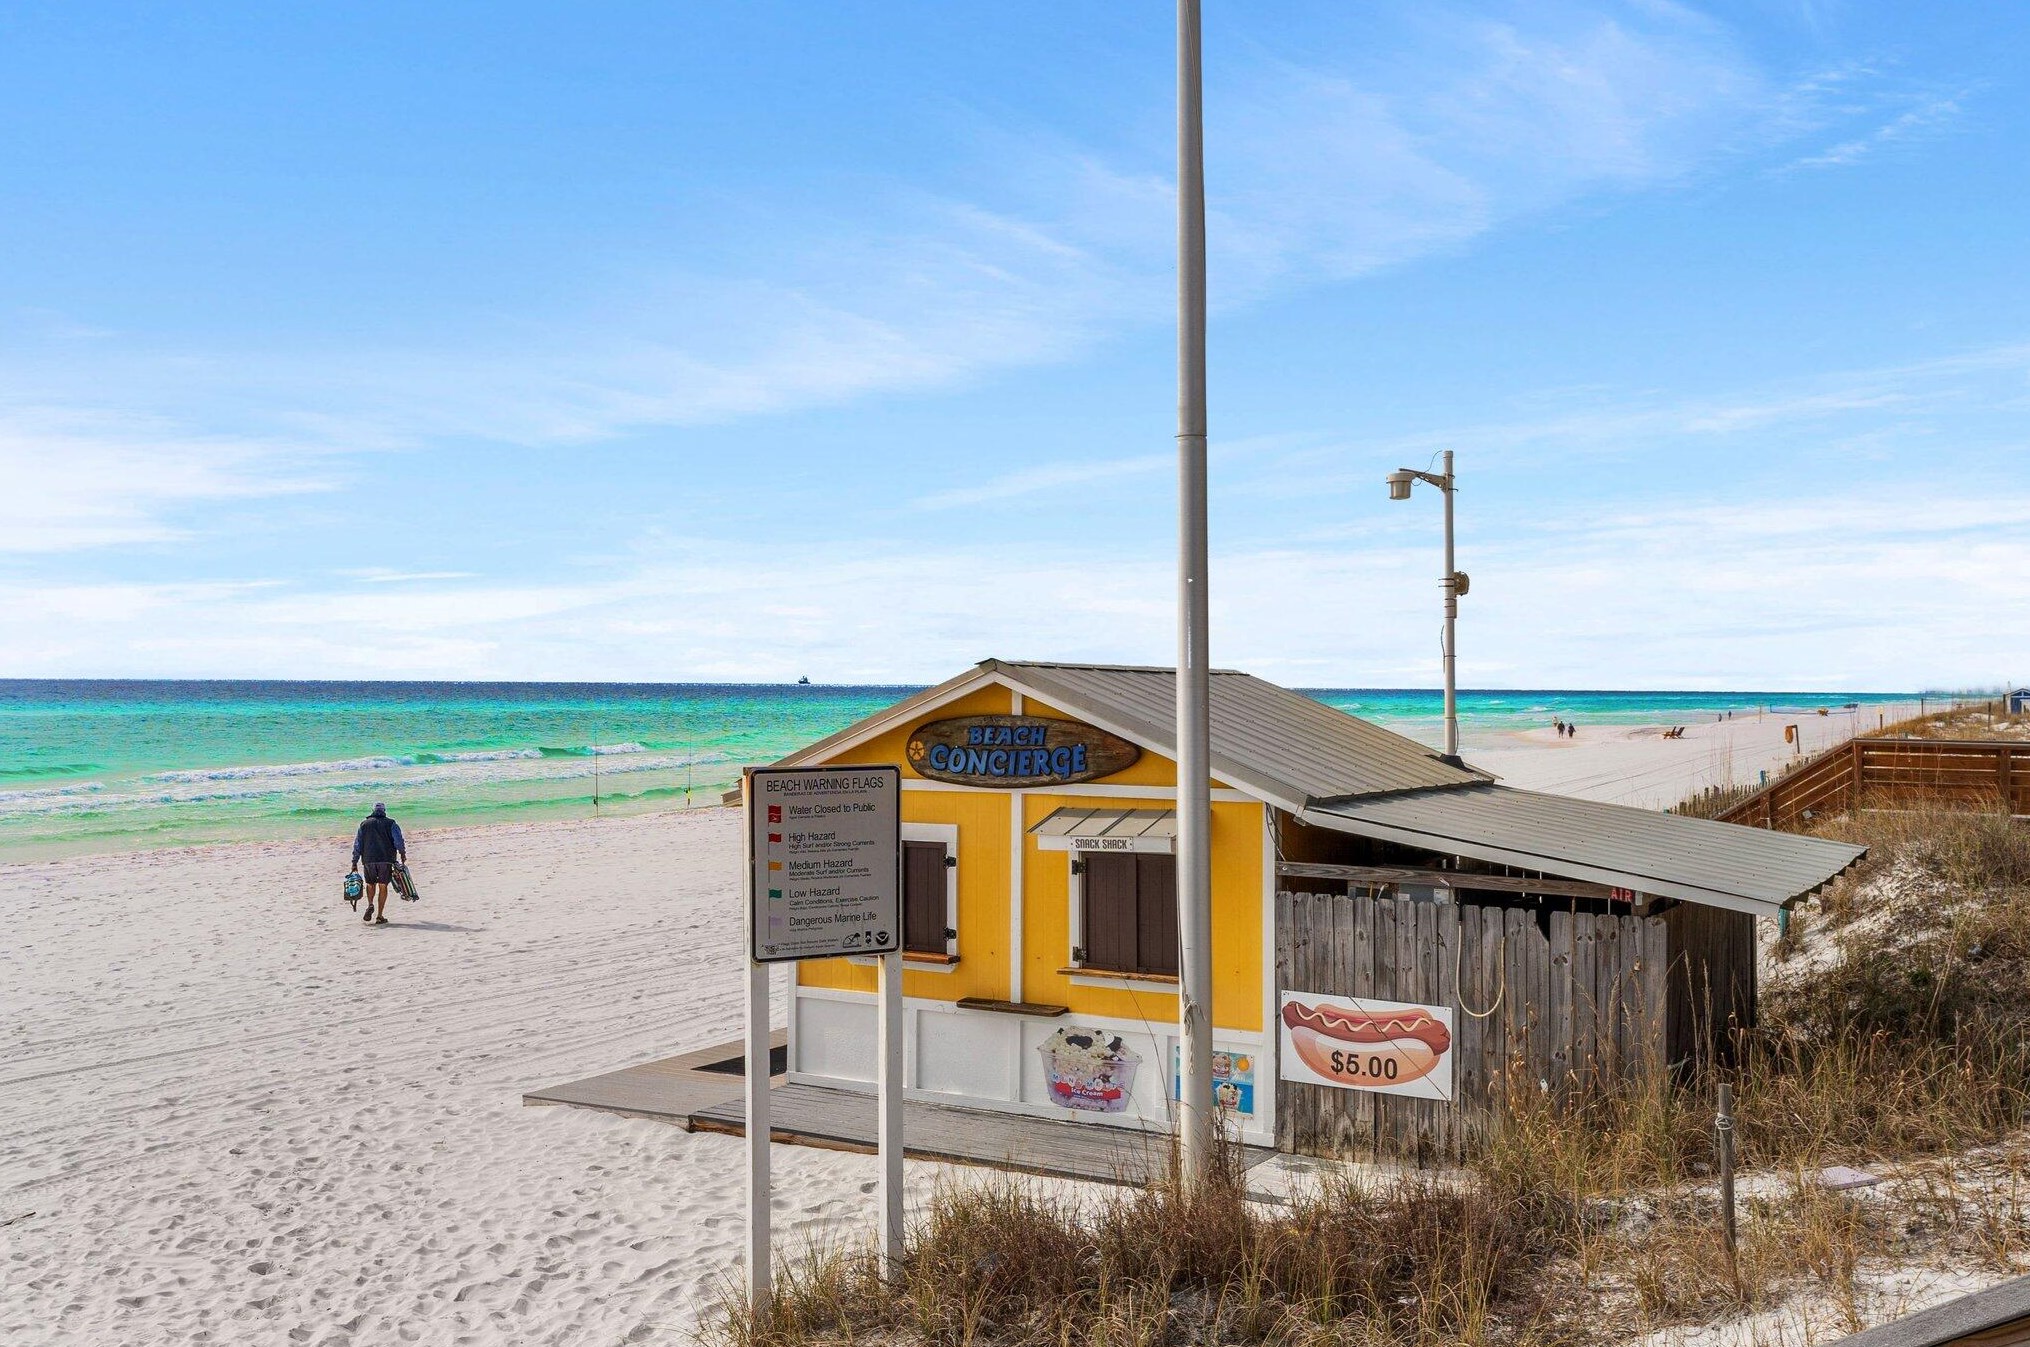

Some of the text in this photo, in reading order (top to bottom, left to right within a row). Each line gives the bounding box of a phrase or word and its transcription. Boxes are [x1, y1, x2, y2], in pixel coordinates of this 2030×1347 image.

[968, 724, 1047, 746] BEACH
[930, 744, 1087, 779] CONCIERGE
[767, 776, 884, 792] BEACH WARNING FLAGS
[788, 802, 876, 815] Water Closed to Public
[788, 831, 836, 843] High Hazard
[833, 840, 851, 848] Strong
[1075, 838, 1128, 849] SNACK SHACK
[788, 858, 853, 870] Medium Hazard
[788, 886, 840, 899] Low Hazard
[1611, 887, 1632, 902] AIR
[789, 911, 877, 927] Dangerous Marine Life
[1330, 1049, 1398, 1080] $5.00
